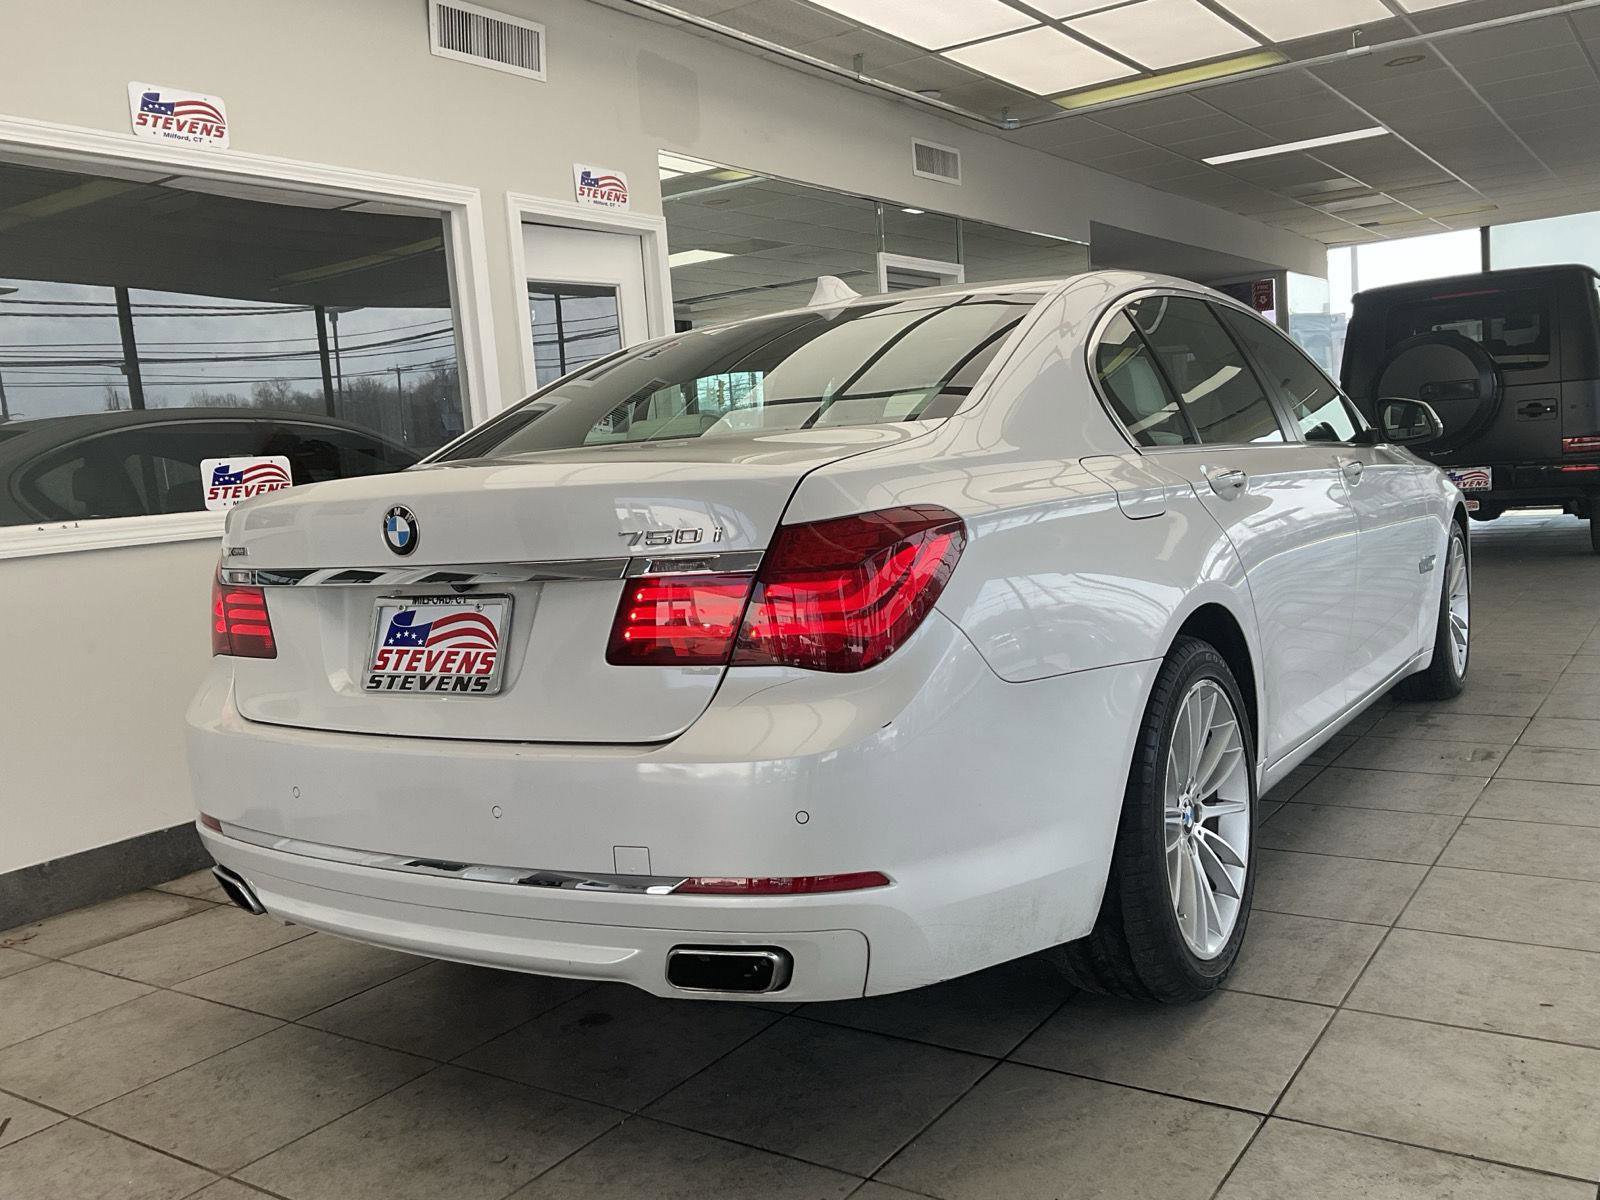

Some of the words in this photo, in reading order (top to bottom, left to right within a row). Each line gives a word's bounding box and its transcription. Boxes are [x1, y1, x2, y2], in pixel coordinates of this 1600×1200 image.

[135, 112, 226, 139] STEVENS
[163, 132, 191, 142] Milford,
[578, 186, 628, 204] STEVENS
[412, 595, 454, 605] MILFORD,
[373, 649, 497, 675] STEVENS
[366, 674, 490, 693] STEVENS
